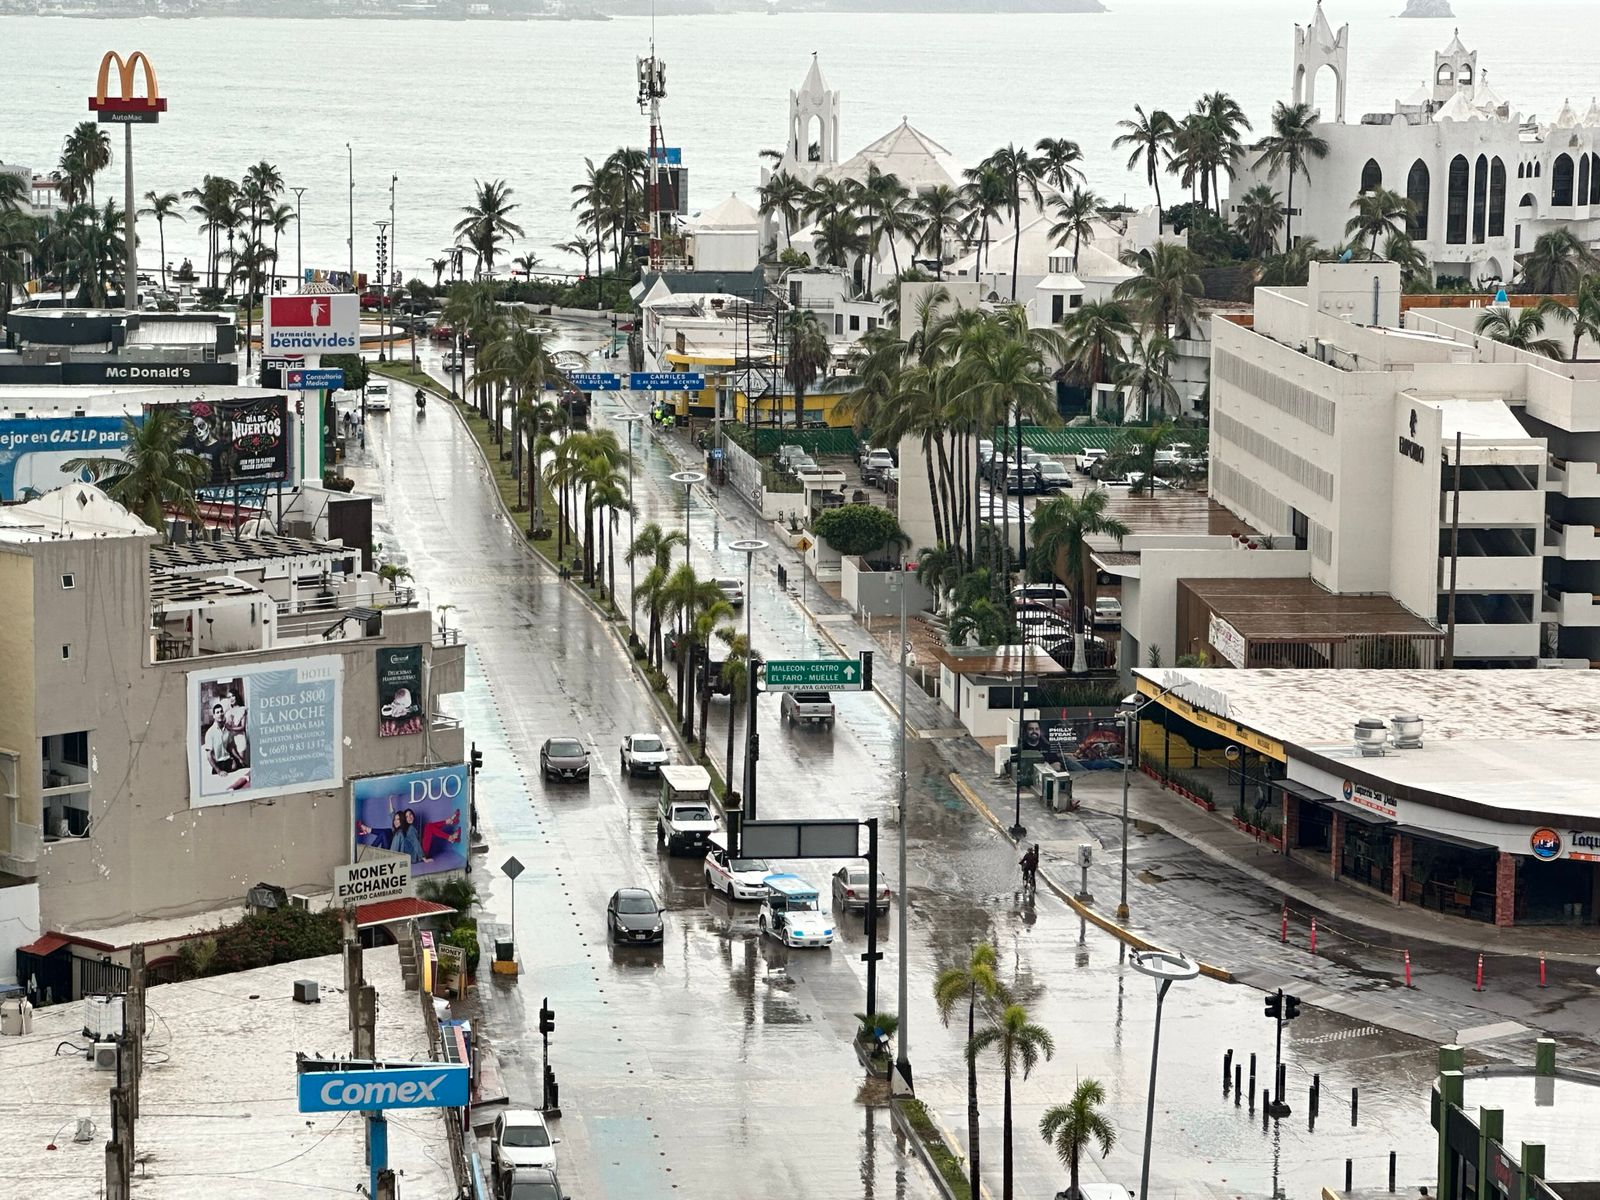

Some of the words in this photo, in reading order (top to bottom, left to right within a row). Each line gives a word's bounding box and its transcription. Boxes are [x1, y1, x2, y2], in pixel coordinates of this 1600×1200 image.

[270, 332, 355, 348] benavides
[267, 361, 304, 370] PEME
[246, 414, 257, 423] DÍA
[31, 432, 48, 443] en
[50, 429, 79, 443] GAS
[80, 429, 98, 442] LP
[99, 431, 129, 445] para
[231, 417, 281, 441] MUERTOS
[301, 667, 331, 680] HOTEL
[771, 664, 805, 672] MALECON
[810, 664, 839, 672] CENTRO
[771, 674, 780, 682] EL
[782, 674, 803, 682] FARO
[260, 694, 296, 709] DESDE
[299, 688, 325, 704] $800
[260, 711, 275, 725] LA
[279, 705, 325, 722] NOCHE
[260, 722, 306, 735] TEMPORADA
[308, 719, 325, 729] BAJA
[269, 744, 288, 756] (669)
[290, 743, 295, 752] 9
[295, 741, 305, 751] 83
[408, 774, 461, 804] DUO
[348, 862, 397, 882] MONEY
[338, 874, 407, 897] EXCHANGE
[343, 893, 368, 904] CENTRO
[368, 888, 403, 900] CAMBIARIO
[440, 946, 462, 956] MONEY
[320, 1073, 449, 1106] Comex
